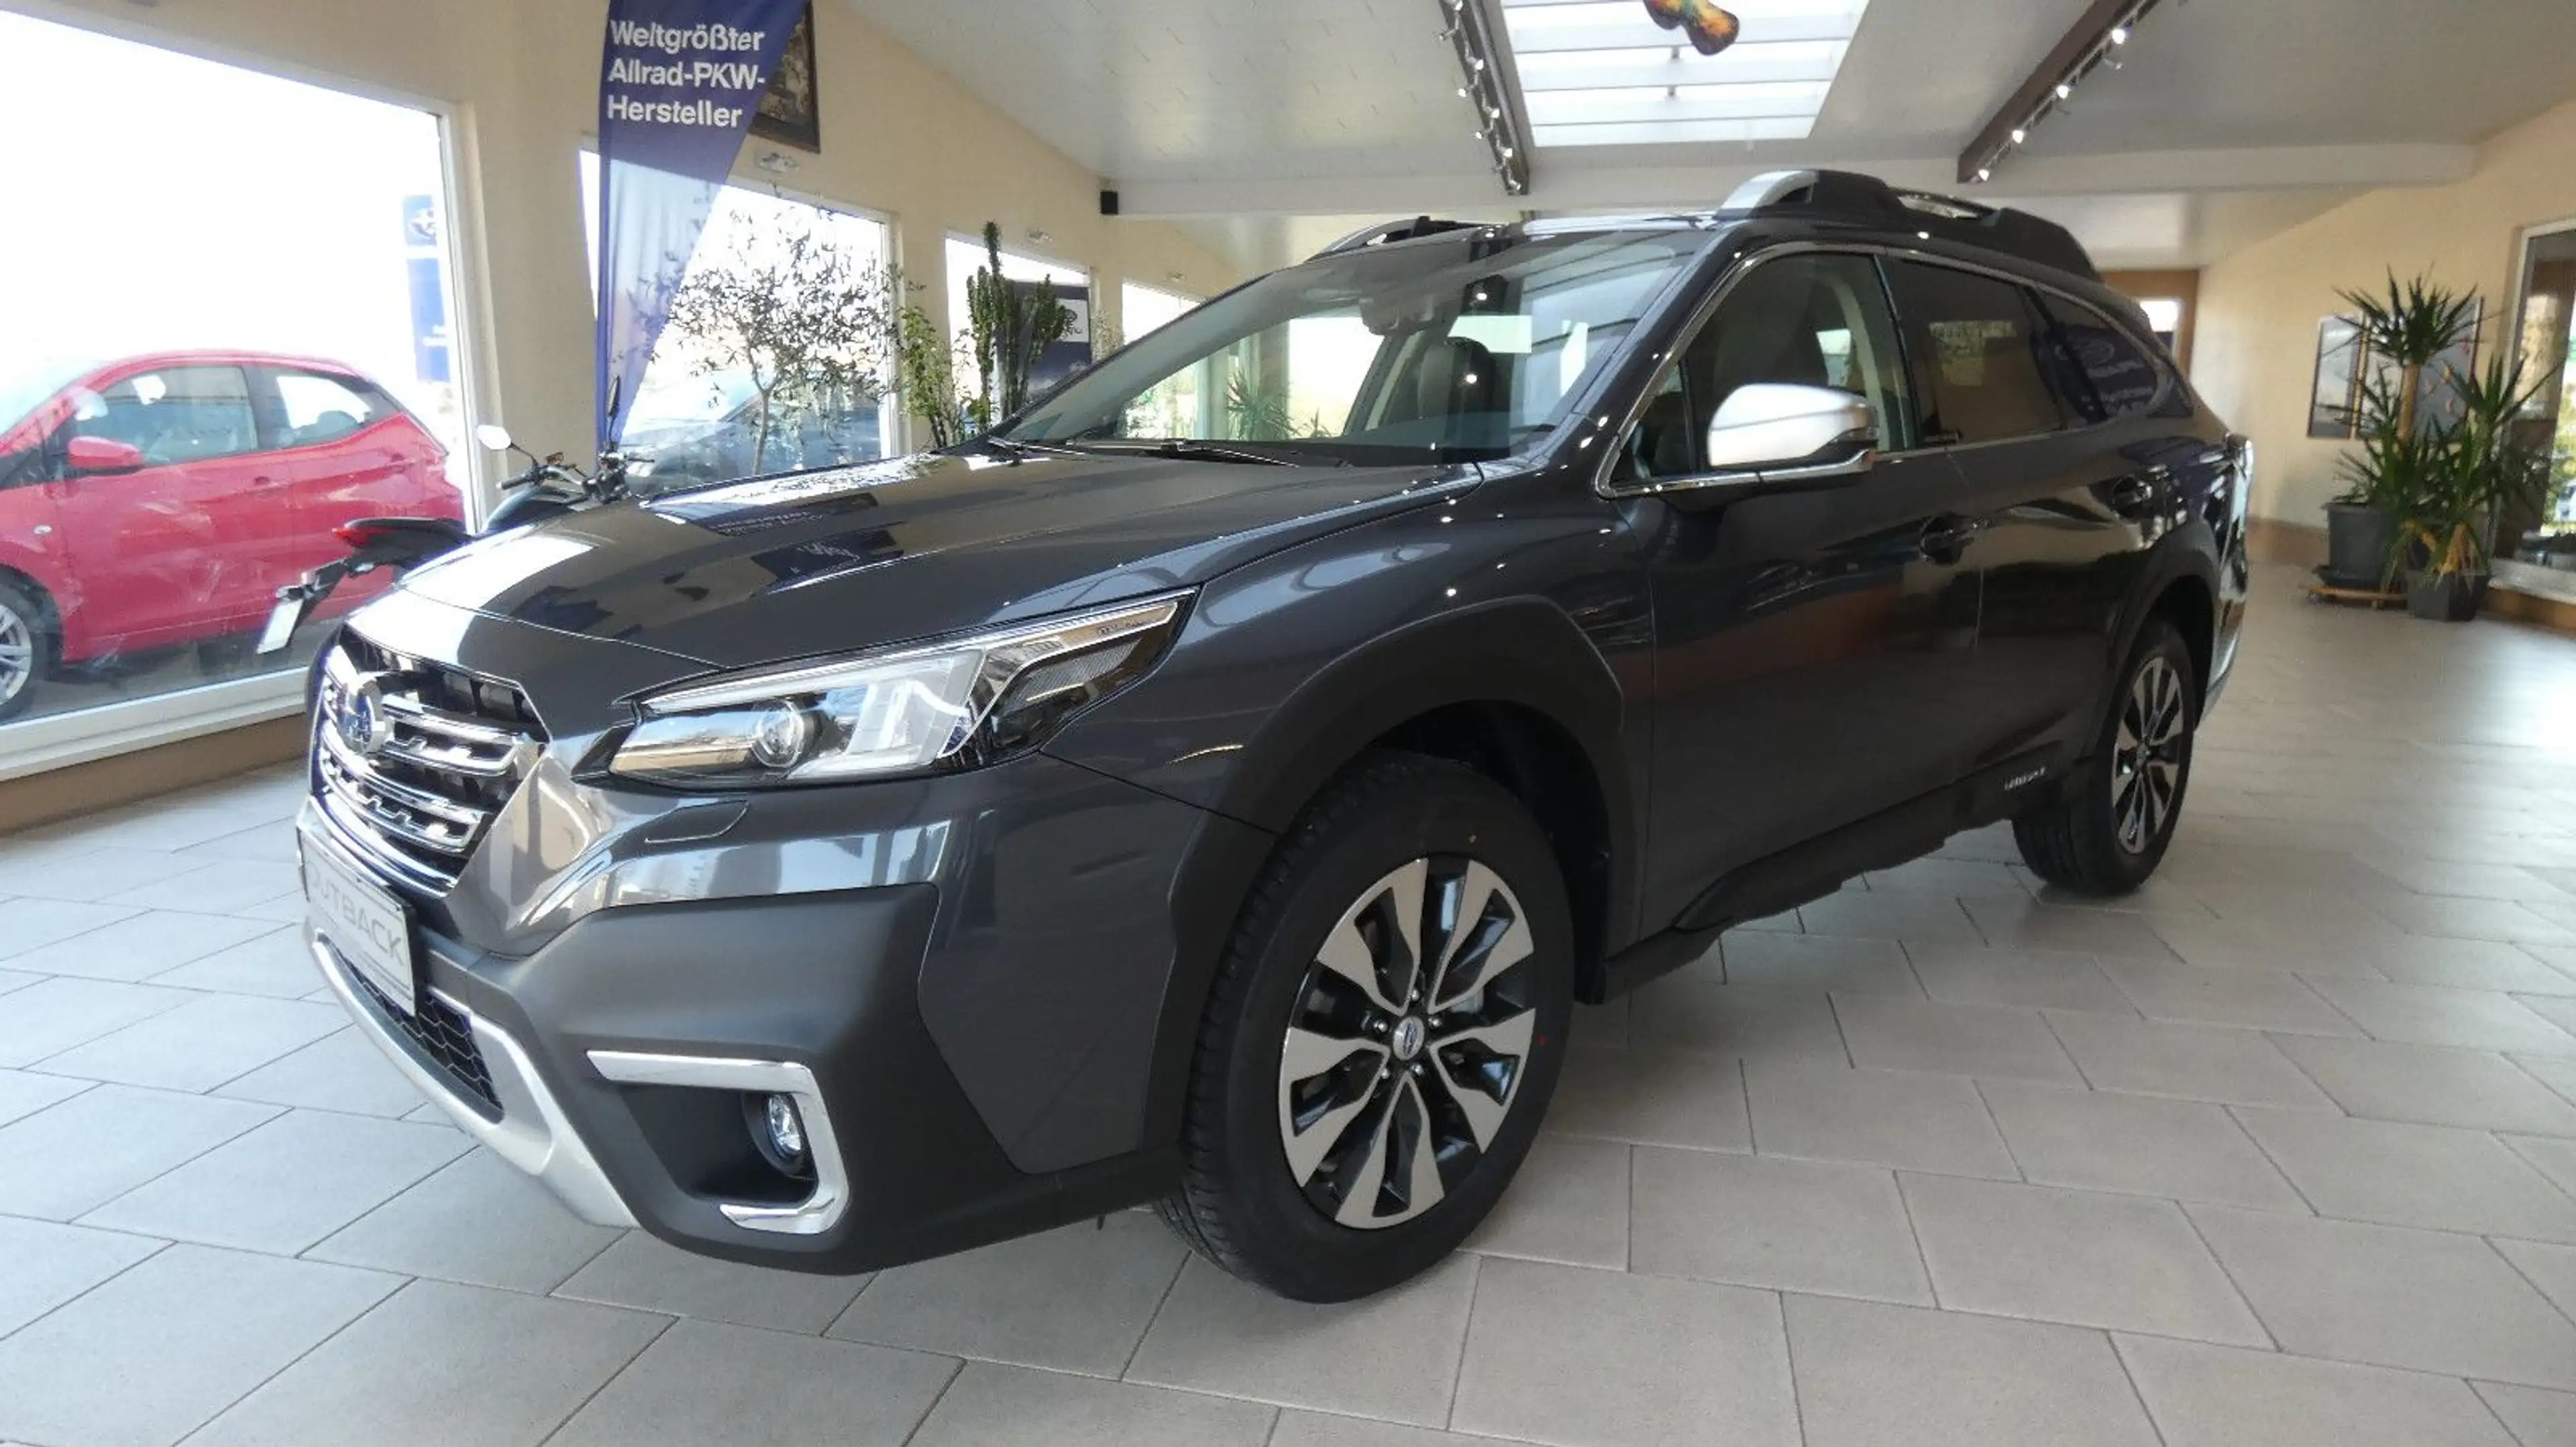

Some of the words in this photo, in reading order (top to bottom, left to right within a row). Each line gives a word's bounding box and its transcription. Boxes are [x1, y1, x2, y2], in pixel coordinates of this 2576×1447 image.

[610, 20, 765, 54] Weltgrößter
[607, 58, 766, 90] Allrad-PKW-
[607, 95, 743, 127] Hersteller
